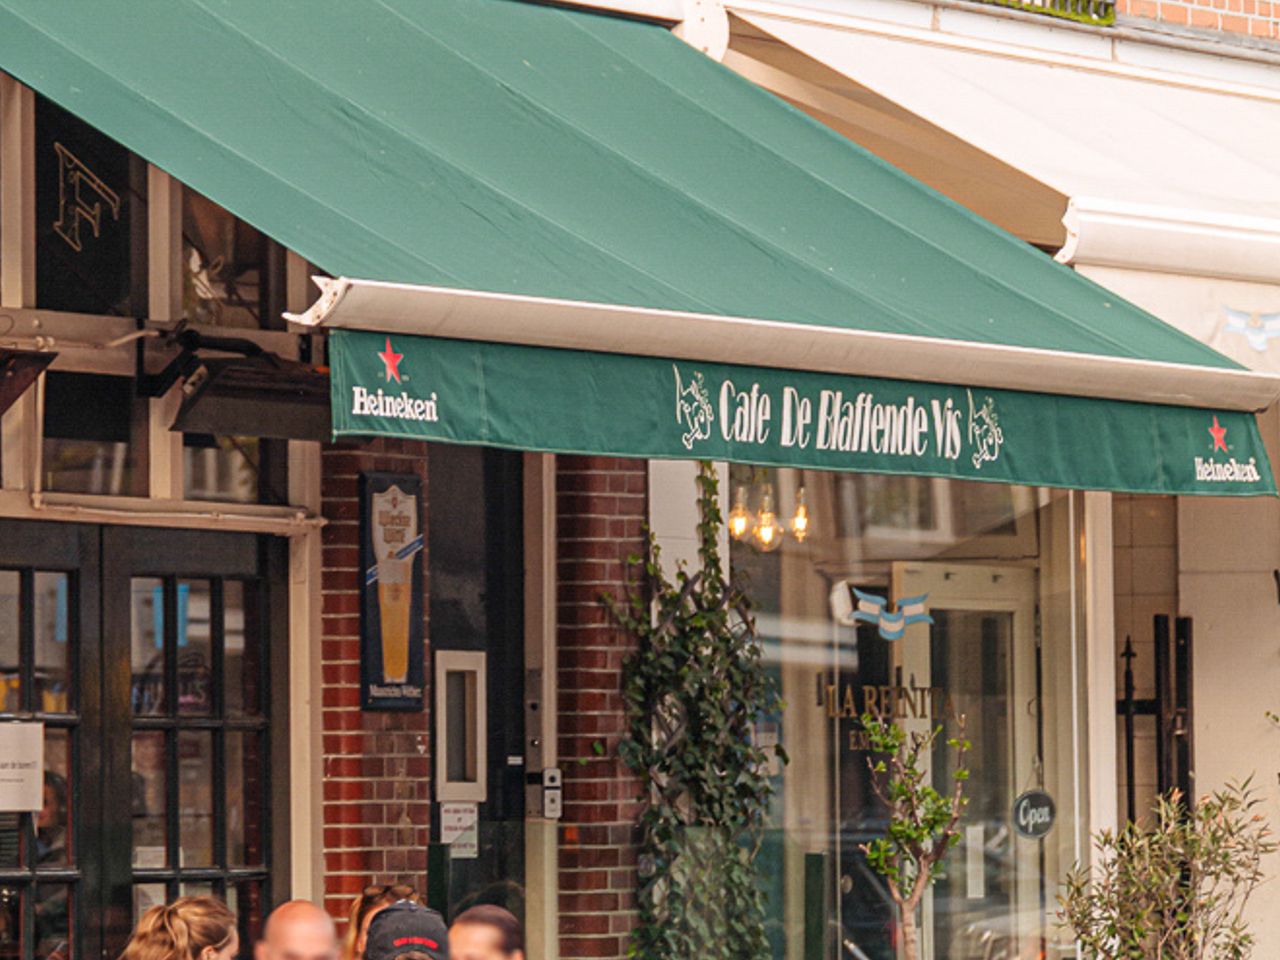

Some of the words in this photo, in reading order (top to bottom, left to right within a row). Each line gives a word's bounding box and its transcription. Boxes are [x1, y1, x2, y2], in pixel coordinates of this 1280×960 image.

[352, 386, 439, 422] Heineken
[719, 379, 771, 444] Cafe
[780, 386, 811, 449] De
[815, 390, 928, 456] Blaffende
[931, 398, 962, 460] Vis
[1194, 457, 1261, 482] Heineken
